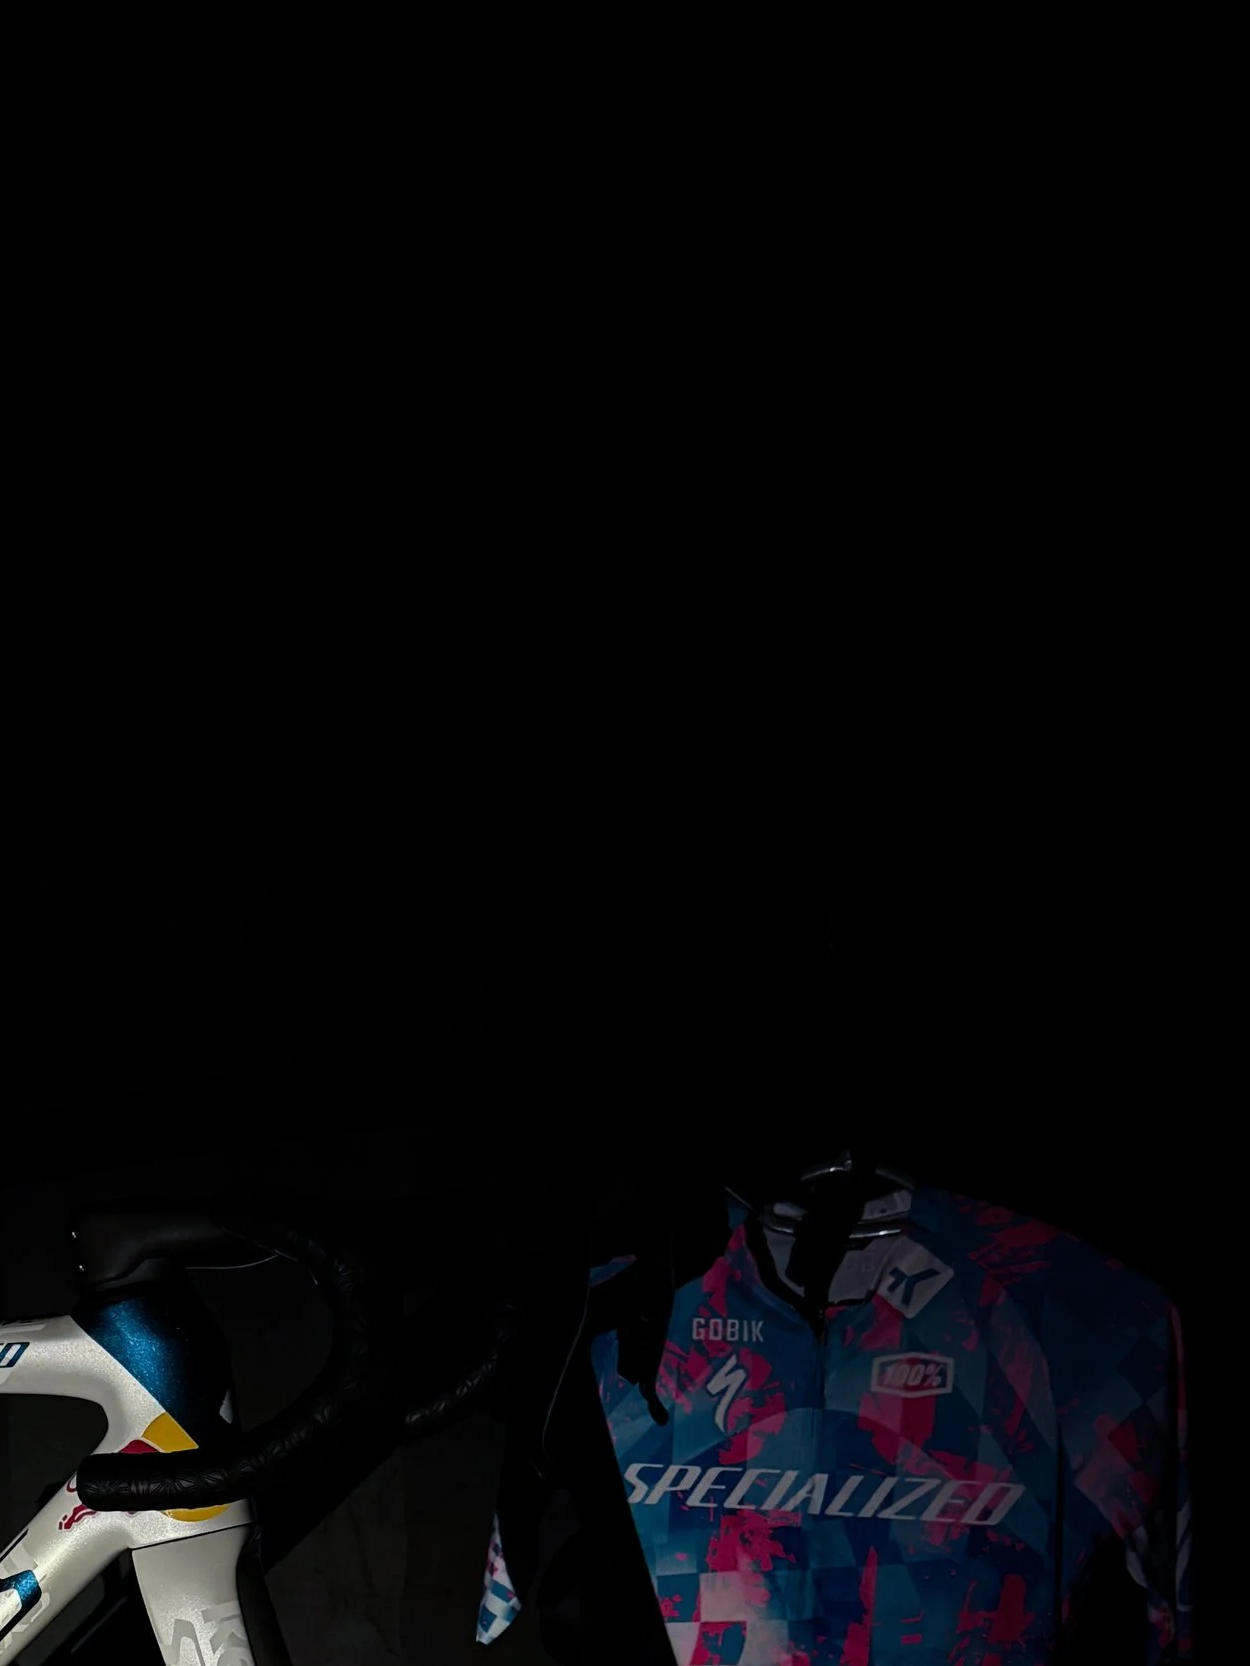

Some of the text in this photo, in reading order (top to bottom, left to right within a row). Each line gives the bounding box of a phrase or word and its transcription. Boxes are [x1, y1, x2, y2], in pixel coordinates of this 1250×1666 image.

[692, 1317, 764, 1342] GOBIK
[881, 1363, 943, 1388] 100%
[623, 1463, 1025, 1526] SPECIALIZED
